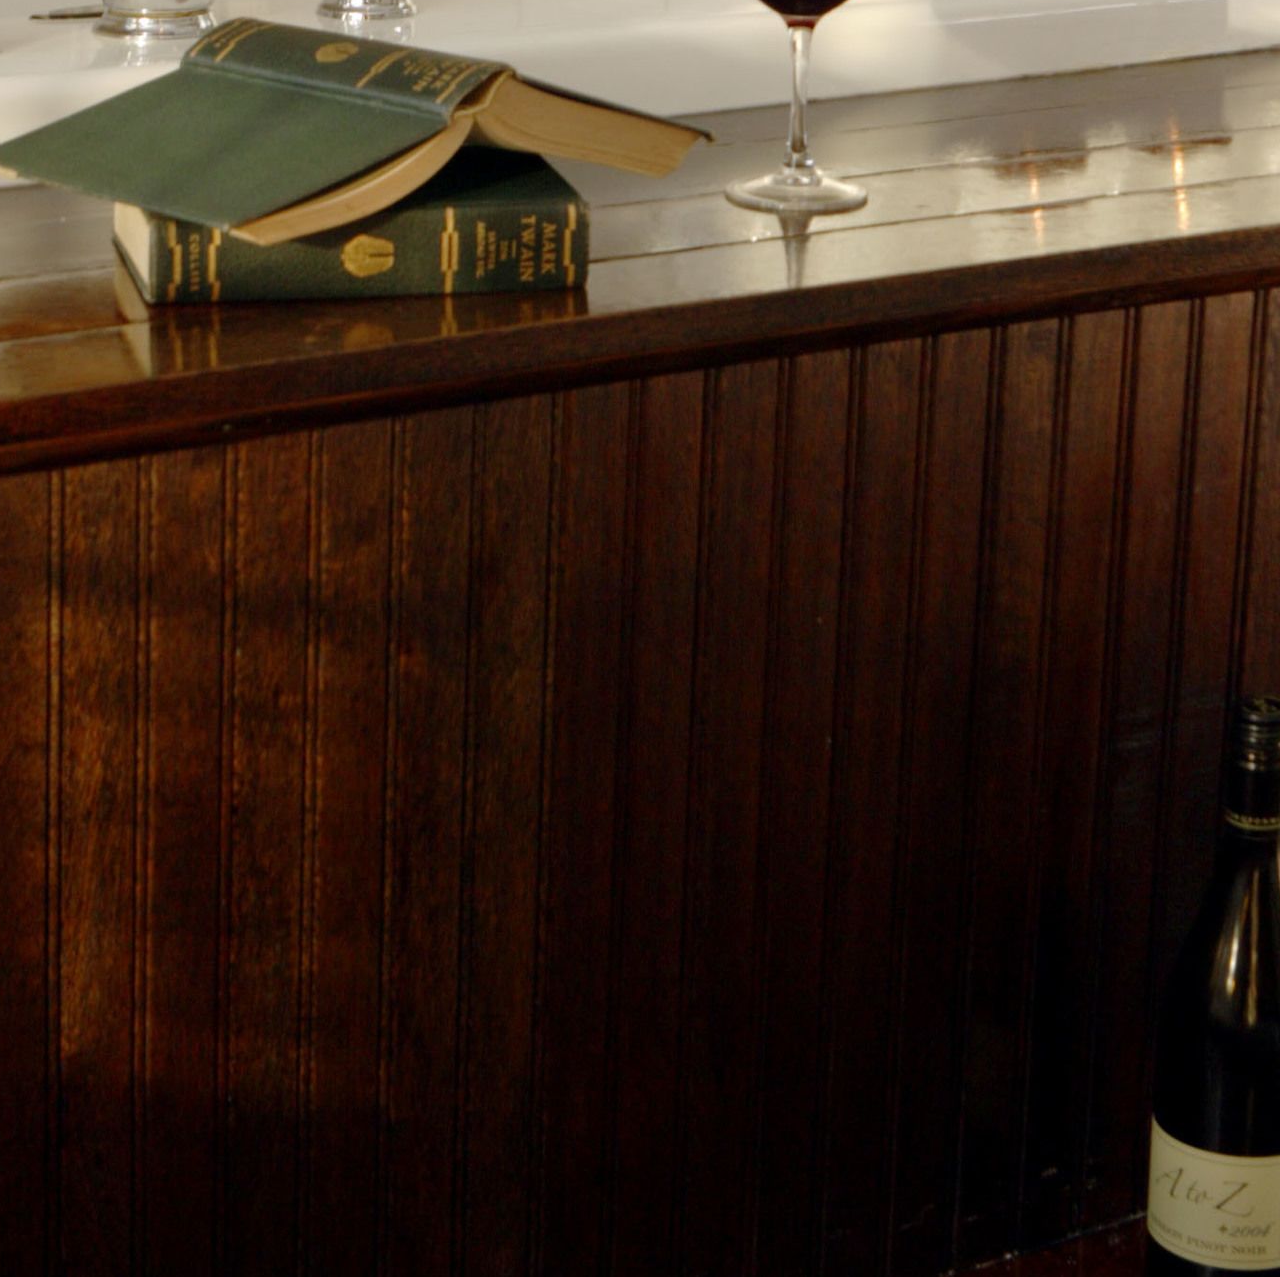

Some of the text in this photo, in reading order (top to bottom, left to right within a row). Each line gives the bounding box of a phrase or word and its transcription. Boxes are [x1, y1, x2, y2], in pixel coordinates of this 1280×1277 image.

[520, 215, 536, 282] TWAIN
[542, 222, 557, 275] MARK
[1155, 1167, 1255, 1218] A to Z
[1187, 1236, 1227, 1254] PINOT
[1231, 1244, 1267, 1255] NOIR
